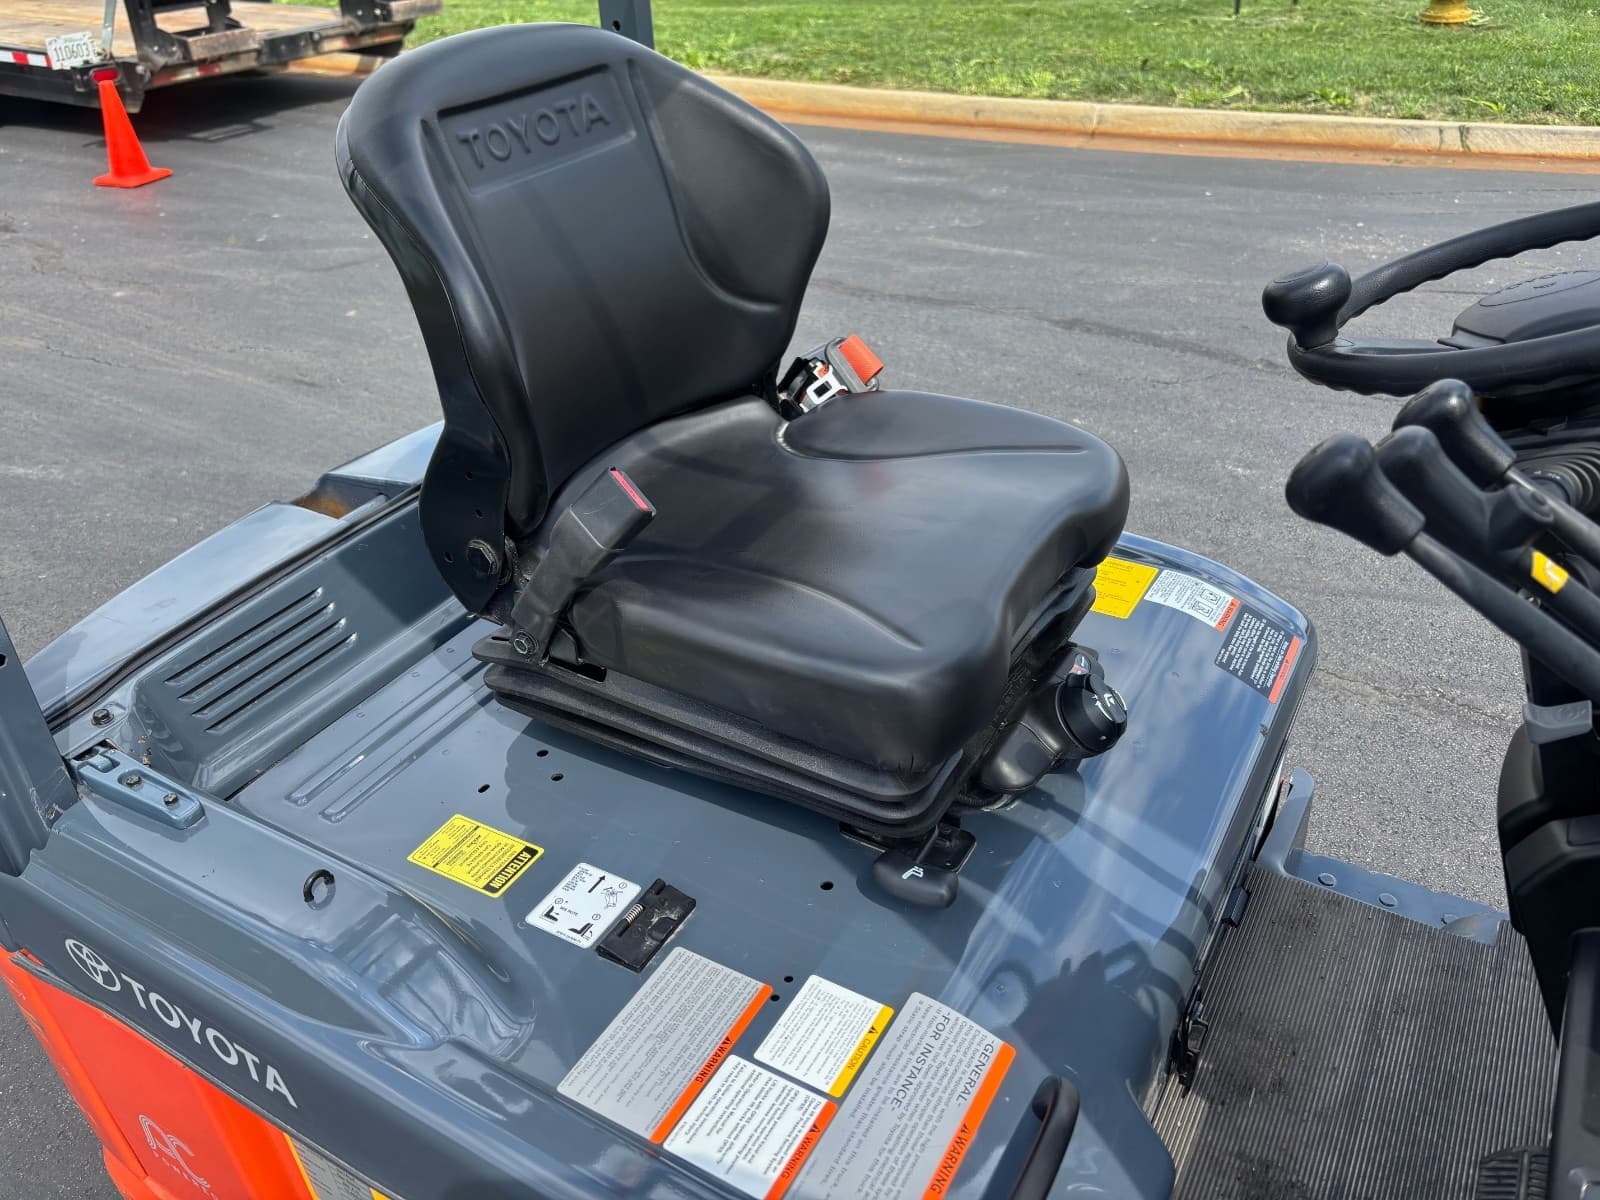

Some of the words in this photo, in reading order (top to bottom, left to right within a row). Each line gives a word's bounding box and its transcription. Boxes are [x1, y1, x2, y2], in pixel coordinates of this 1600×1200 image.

[456, 93, 610, 168] TOYOTA
[487, 850, 533, 889] ATTENTION
[120, 973, 298, 1108] TOYOTA
[929, 1010, 953, 1041] -FOR
[693, 1044, 728, 1084] WARNING
[846, 1037, 871, 1070] CAUTION
[886, 1042, 935, 1112] INSTANCE-
[953, 1037, 997, 1108] -GENERAL-
[779, 1135, 813, 1180] WARNING
[928, 1134, 968, 1195] WARNING
